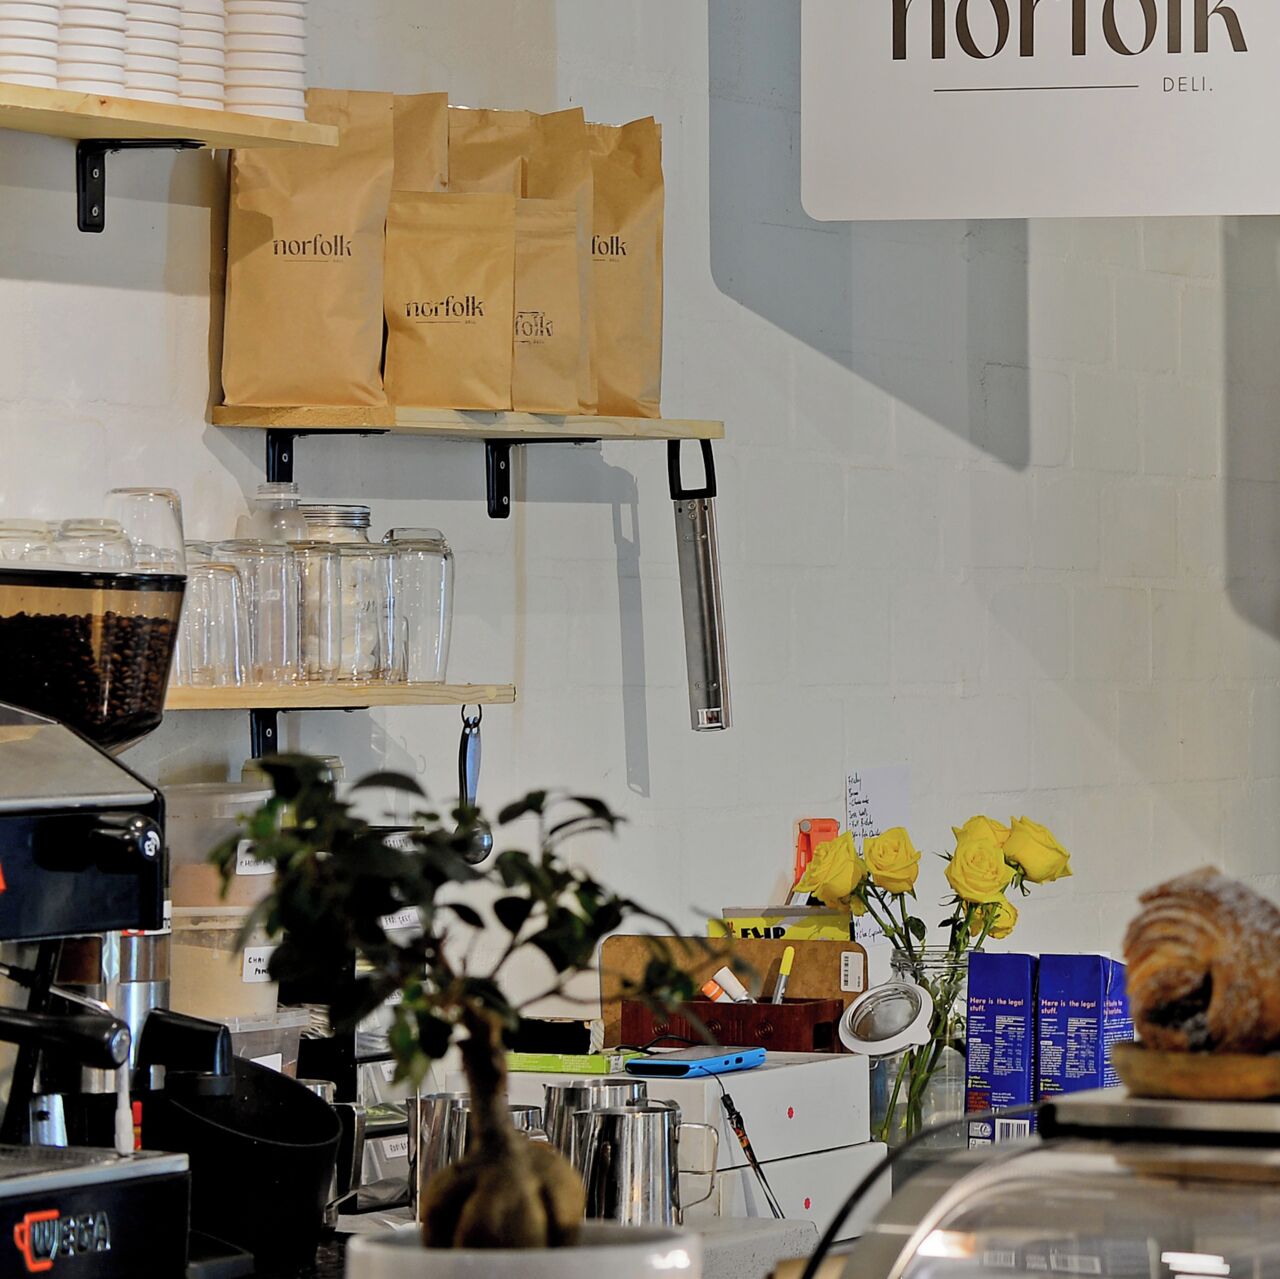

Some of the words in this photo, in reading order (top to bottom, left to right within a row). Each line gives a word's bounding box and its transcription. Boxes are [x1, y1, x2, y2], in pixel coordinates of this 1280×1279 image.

[1163, 76, 1213, 92] DELI.
[273, 234, 352, 256] norfolk
[592, 235, 626, 256] folk
[405, 296, 484, 318] norfolk
[515, 316, 553, 337] folk
[740, 926, 786, 939] FLIP
[1008, 998, 1024, 1007] legal
[1080, 1000, 1096, 1009] legal
